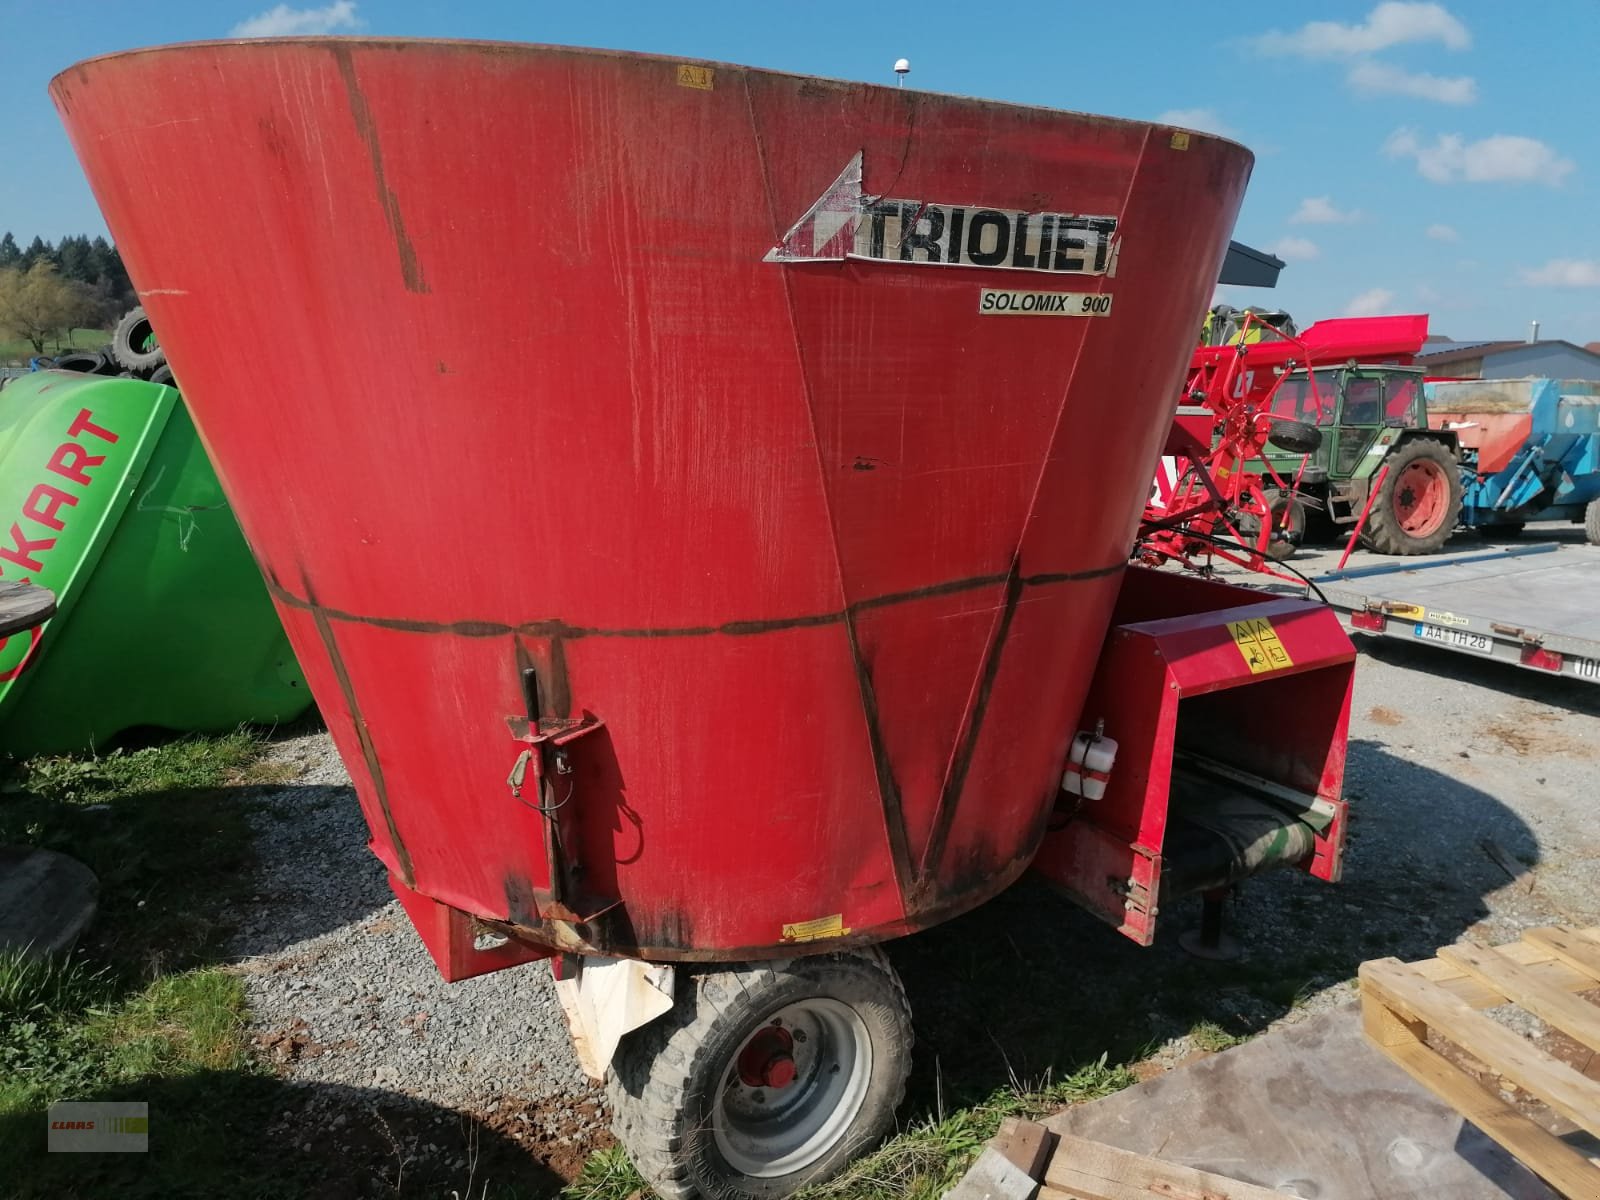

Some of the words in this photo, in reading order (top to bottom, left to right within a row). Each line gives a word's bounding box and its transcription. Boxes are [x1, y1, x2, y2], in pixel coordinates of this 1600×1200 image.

[864, 201, 1117, 271] TRIOLIET
[982, 293, 1067, 311] SOLOMIX
[1081, 296, 1110, 313] 900
[1426, 625, 1441, 640] AA
